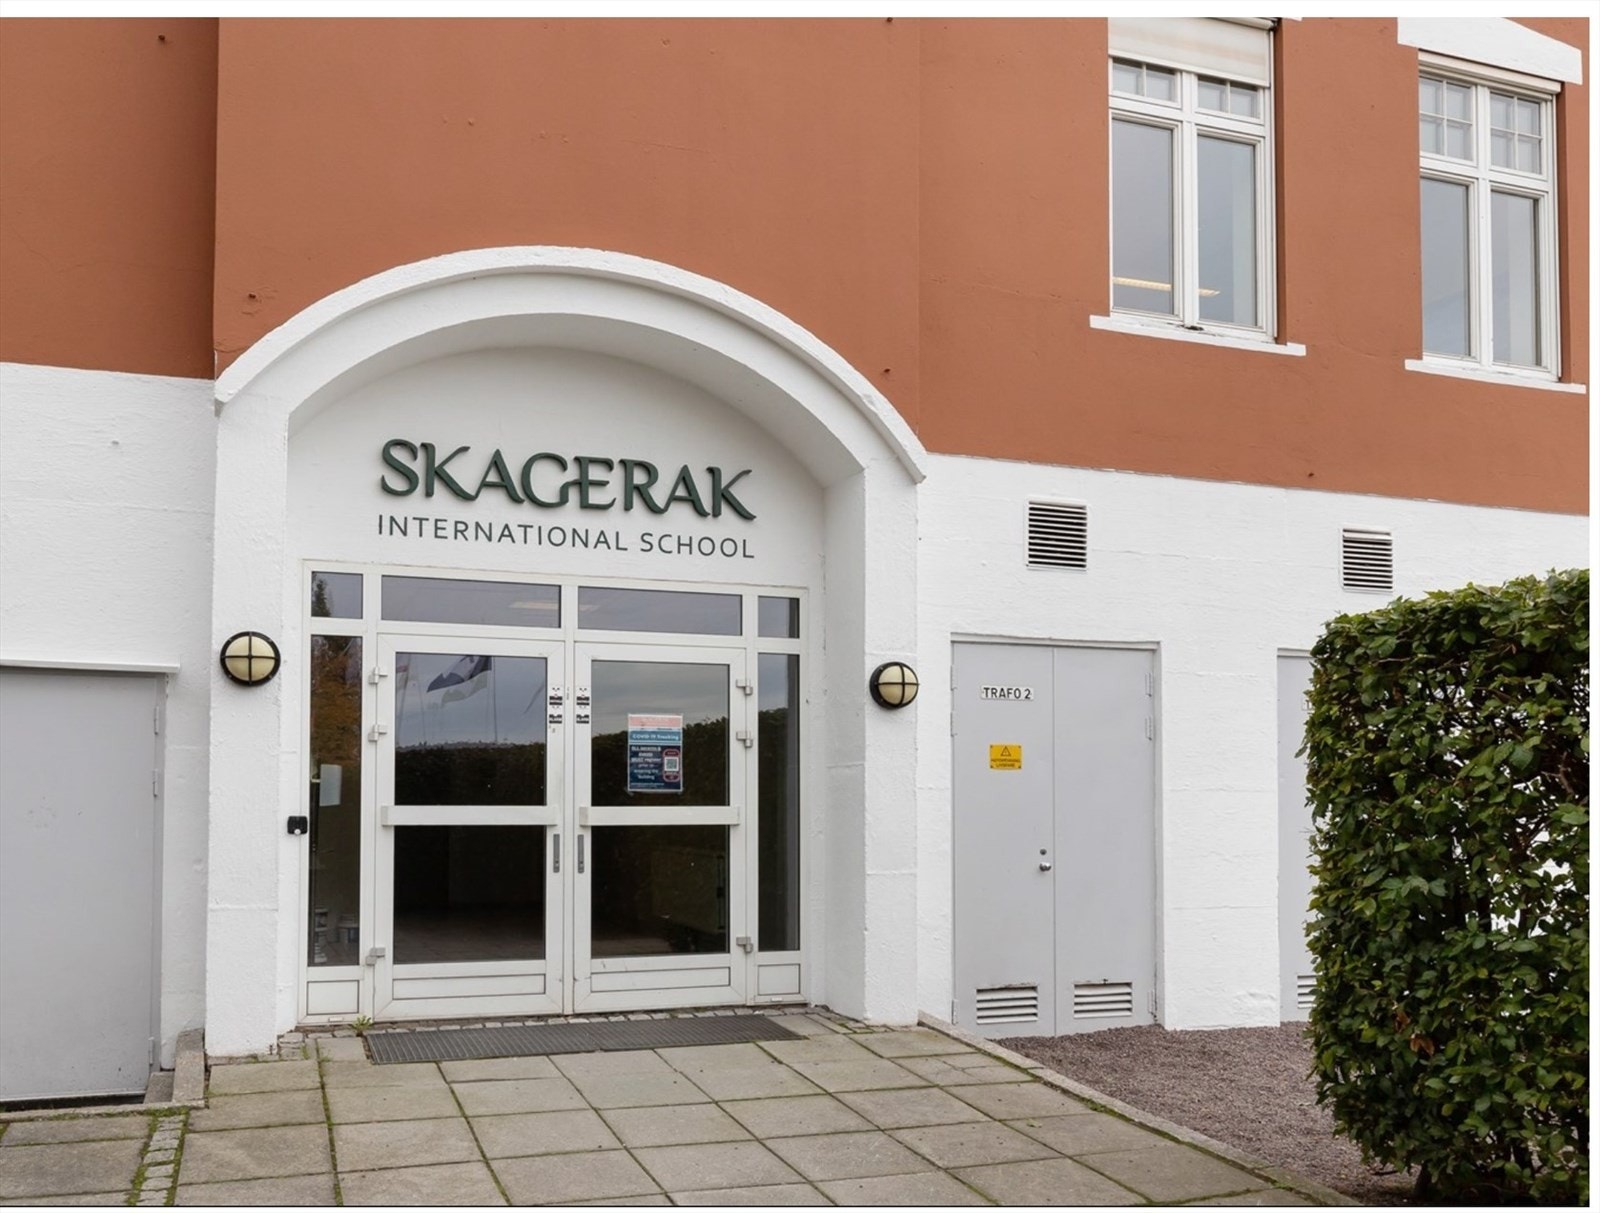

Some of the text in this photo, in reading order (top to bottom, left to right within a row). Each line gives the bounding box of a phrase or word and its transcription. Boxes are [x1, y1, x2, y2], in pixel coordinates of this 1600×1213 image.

[380, 438, 757, 521] SKAGERAK
[378, 514, 755, 559] INTERNATIONAL SCHOOL
[983, 686, 1031, 700] TRAFO 2
